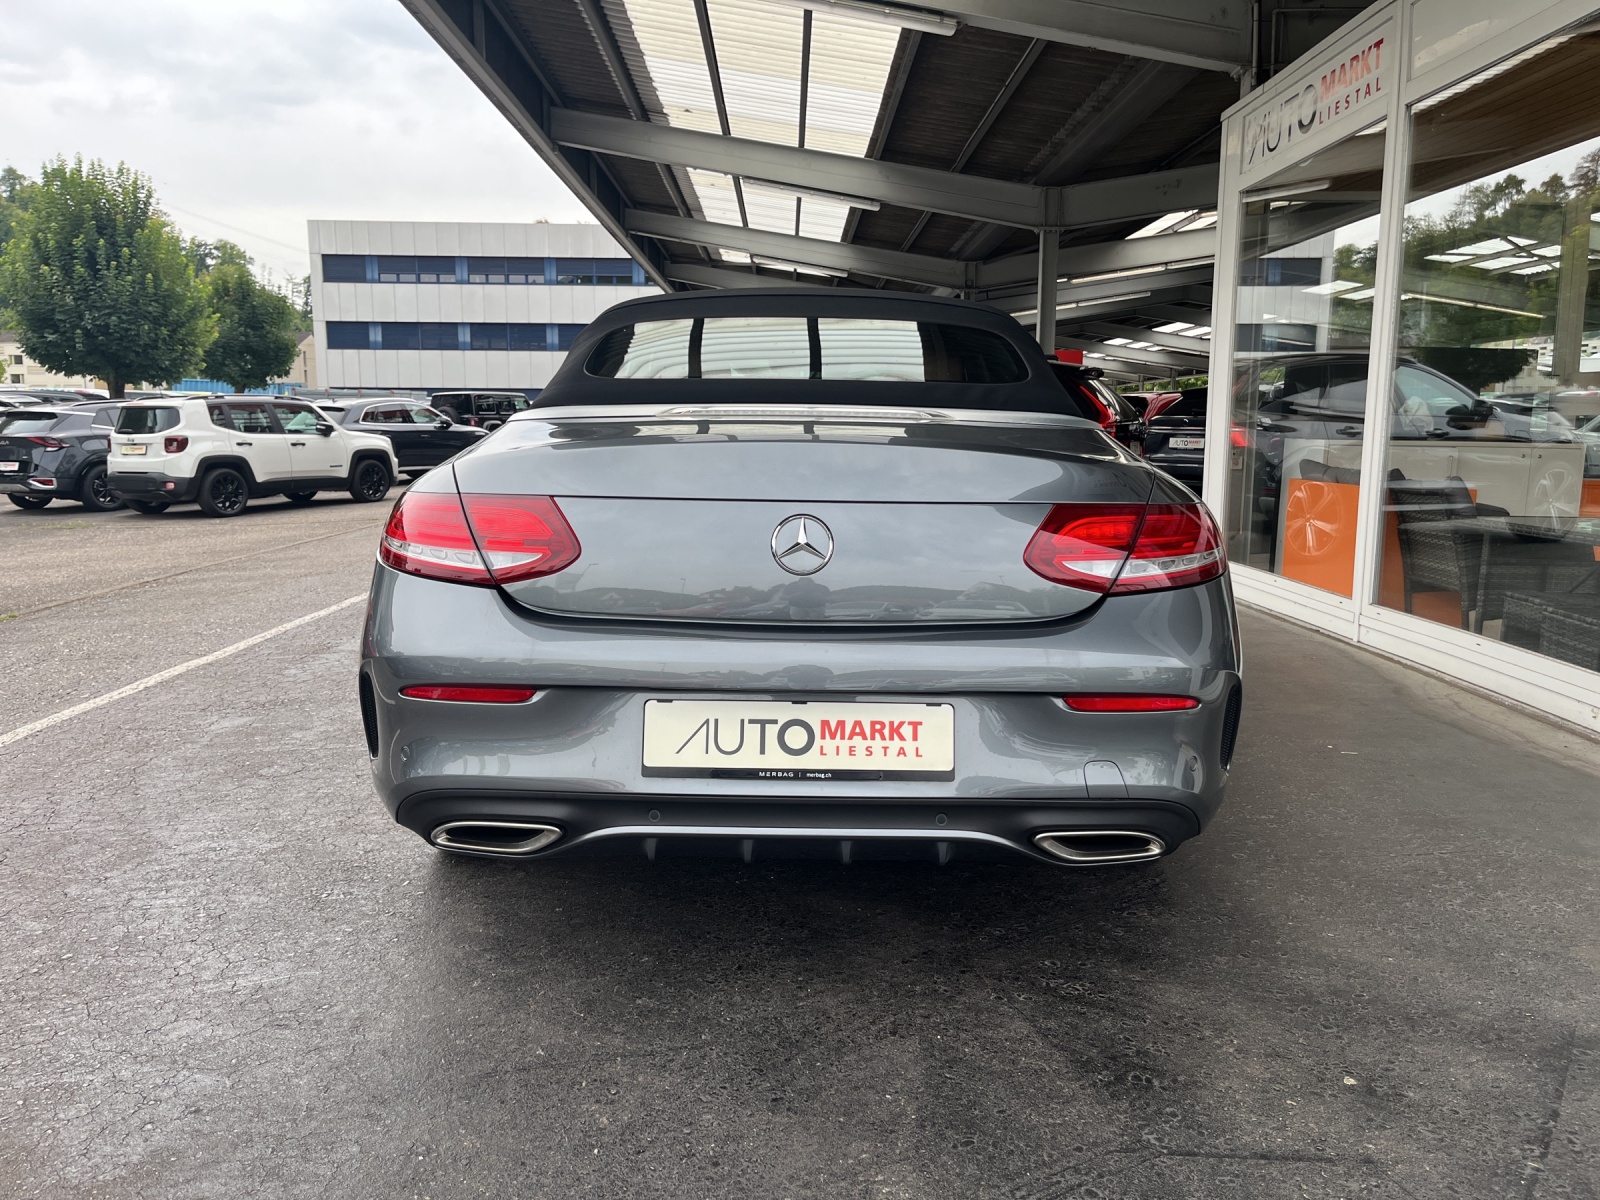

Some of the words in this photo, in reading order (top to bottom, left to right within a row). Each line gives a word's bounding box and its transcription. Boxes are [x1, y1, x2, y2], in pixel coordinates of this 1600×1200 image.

[1249, 84, 1318, 165] AUTO
[1320, 38, 1384, 103] MARKT
[1319, 77, 1381, 125] LIESTAL
[675, 718, 815, 756] AUTO
[819, 719, 923, 741] MARKT
[819, 745, 923, 757] LIESTAL
